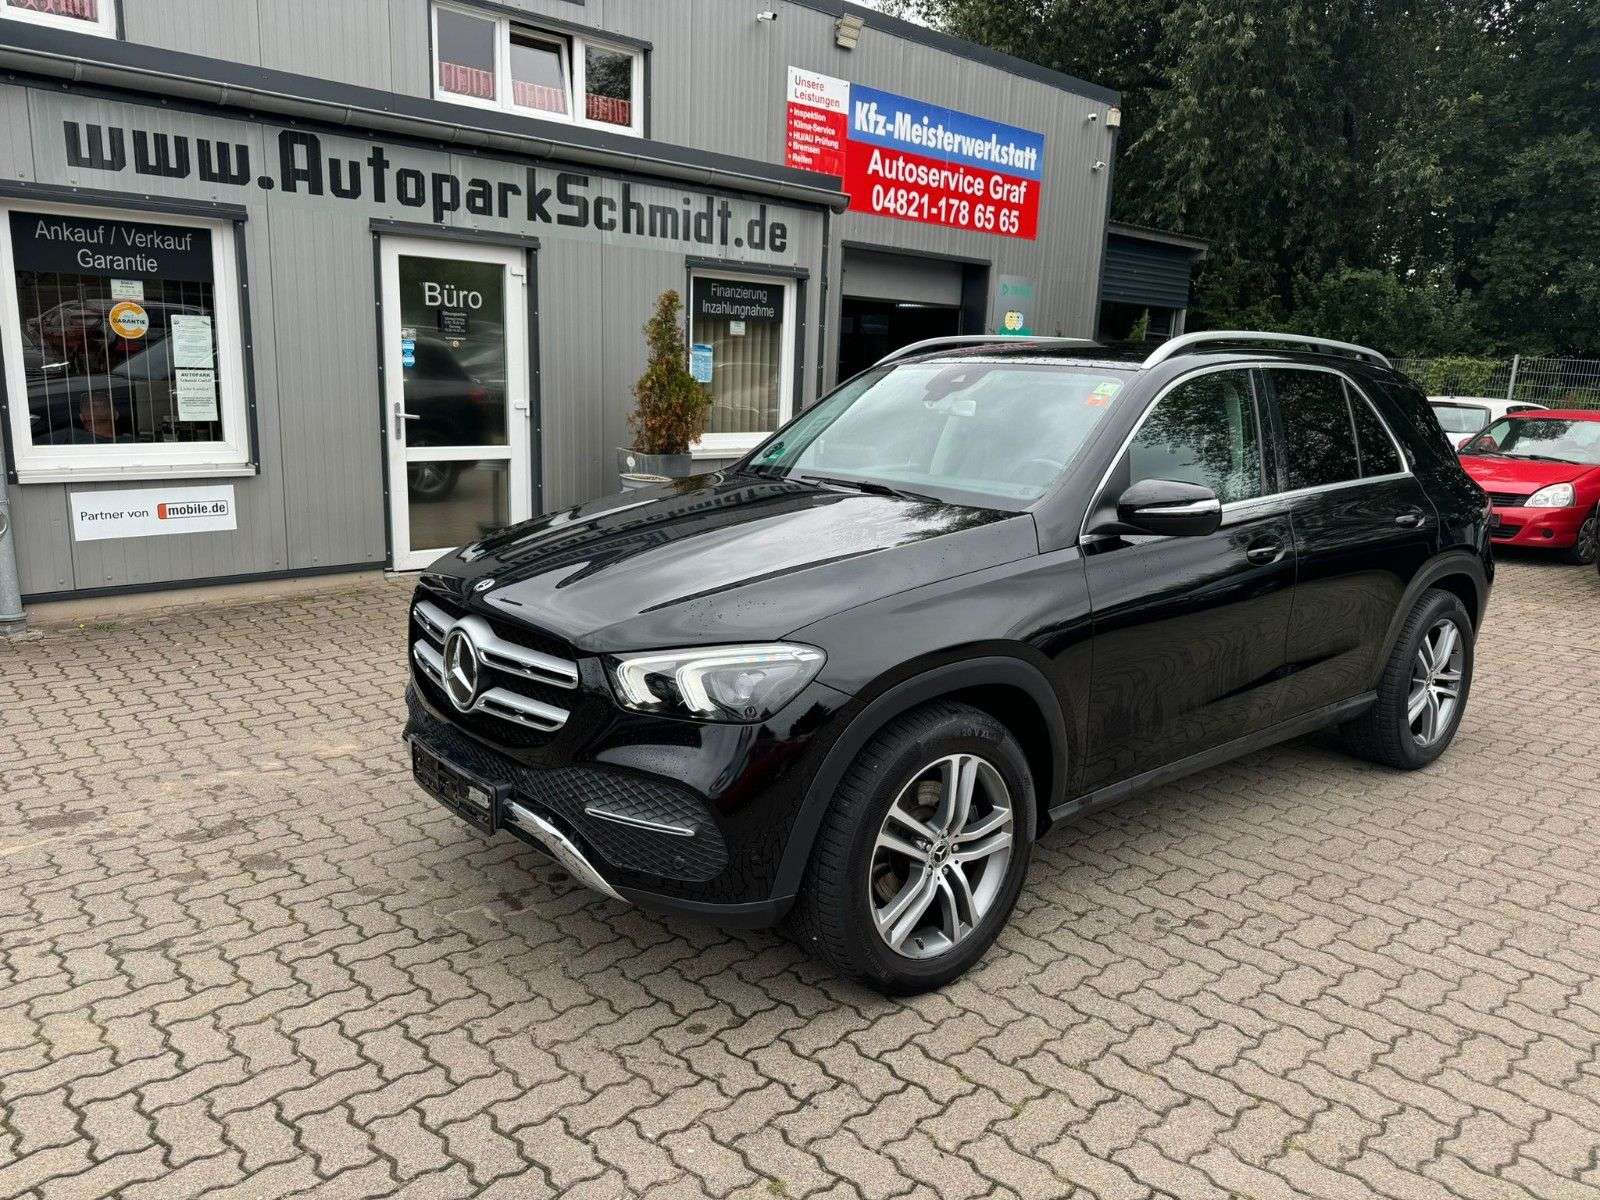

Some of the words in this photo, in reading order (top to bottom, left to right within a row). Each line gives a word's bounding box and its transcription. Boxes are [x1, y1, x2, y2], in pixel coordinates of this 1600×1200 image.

[794, 74, 825, 91] Unsere
[794, 88, 840, 108] Leistungen
[793, 120, 836, 136] Klima-Service
[854, 100, 1037, 171] Kfz-Meisterwerkstatt
[792, 141, 821, 154] Bremsen
[64, 120, 788, 253] www.AutoparkSchmidt.de
[867, 148, 984, 196] Autoservice
[989, 174, 1028, 205] Graf
[871, 183, 970, 226] 04821-178
[973, 203, 995, 230] 65
[999, 207, 1020, 234] 65
[35, 219, 104, 244] Ankauf
[110, 225, 116, 245] /
[121, 227, 192, 251] Verkauf
[77, 248, 158, 273] Garantie
[423, 281, 483, 309] Büro
[711, 283, 768, 303] Finanzierung
[702, 299, 775, 319] Inzahlungnahme
[80, 511, 125, 521] Partner
[127, 509, 149, 518] von
[168, 502, 226, 516] mobile.de
